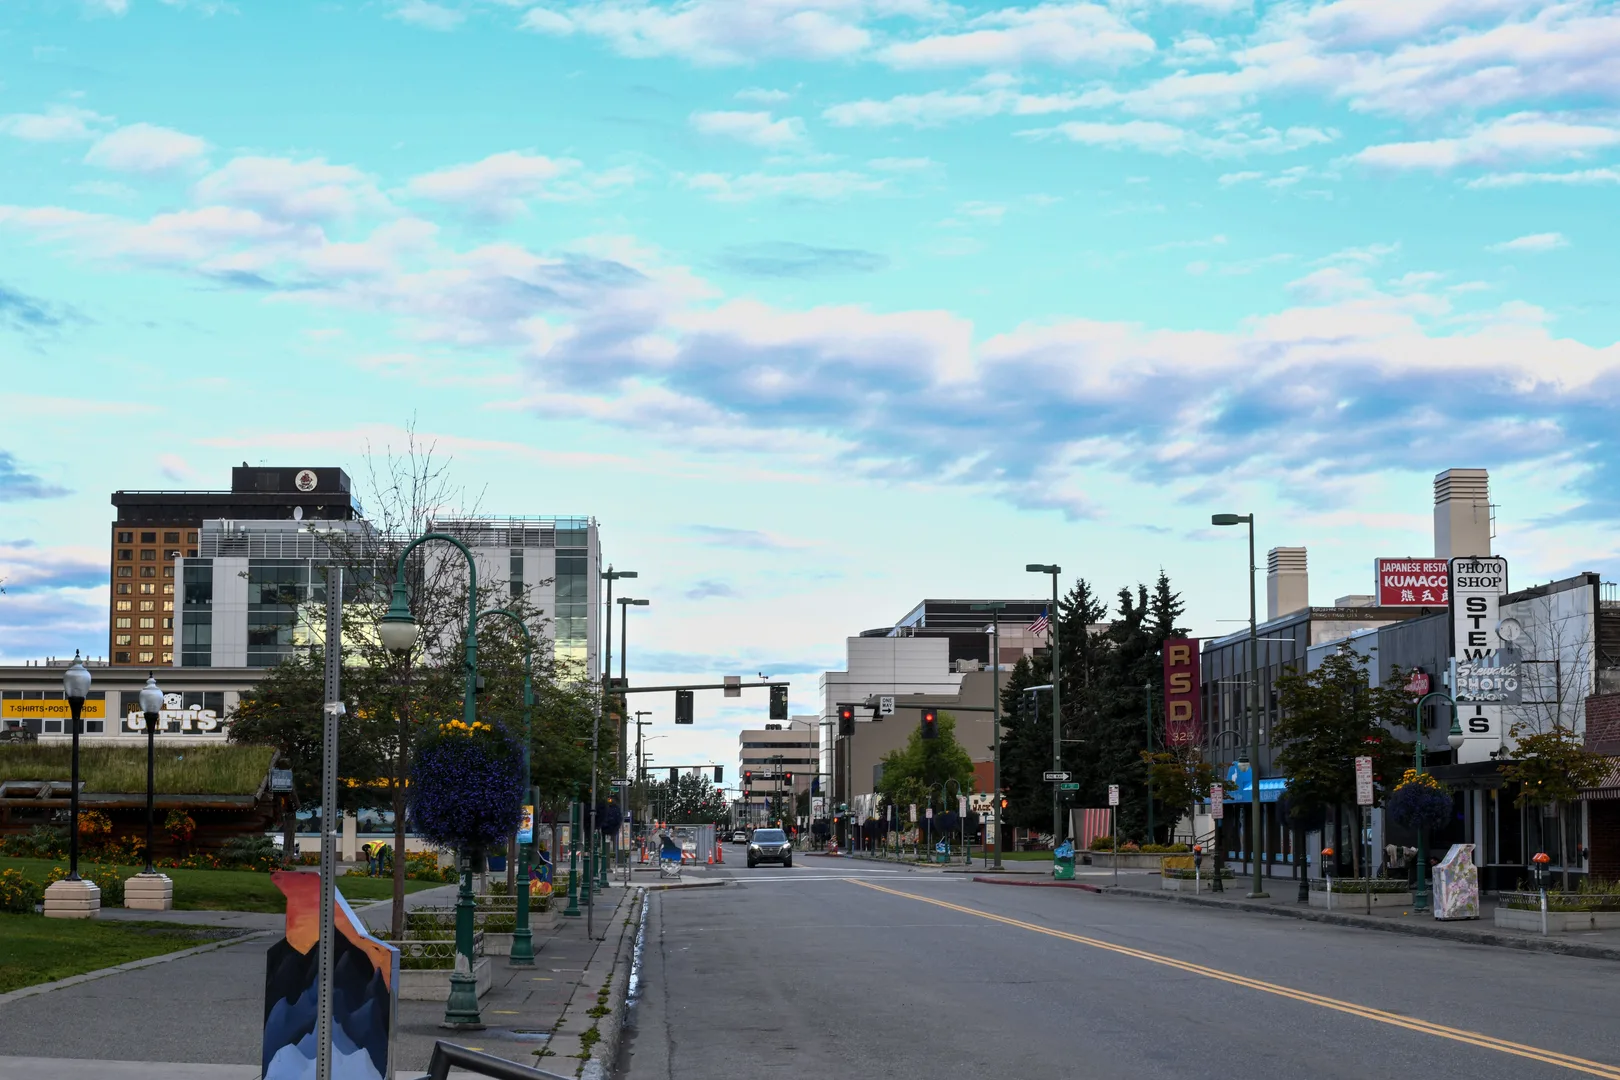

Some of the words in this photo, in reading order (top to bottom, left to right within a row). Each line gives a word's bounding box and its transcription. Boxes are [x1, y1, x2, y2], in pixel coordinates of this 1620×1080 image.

[1381, 563, 1421, 573] JAPANESE
[1423, 563, 1447, 572] RESTA
[1456, 563, 1502, 574] PHOTO
[1384, 575, 1448, 587] KUMAGO
[1457, 577, 1502, 588] SHOP
[1169, 645, 1192, 722] RSD
[1457, 678, 1518, 692] PHOTO
[1464, 692, 1509, 701] SHOP
